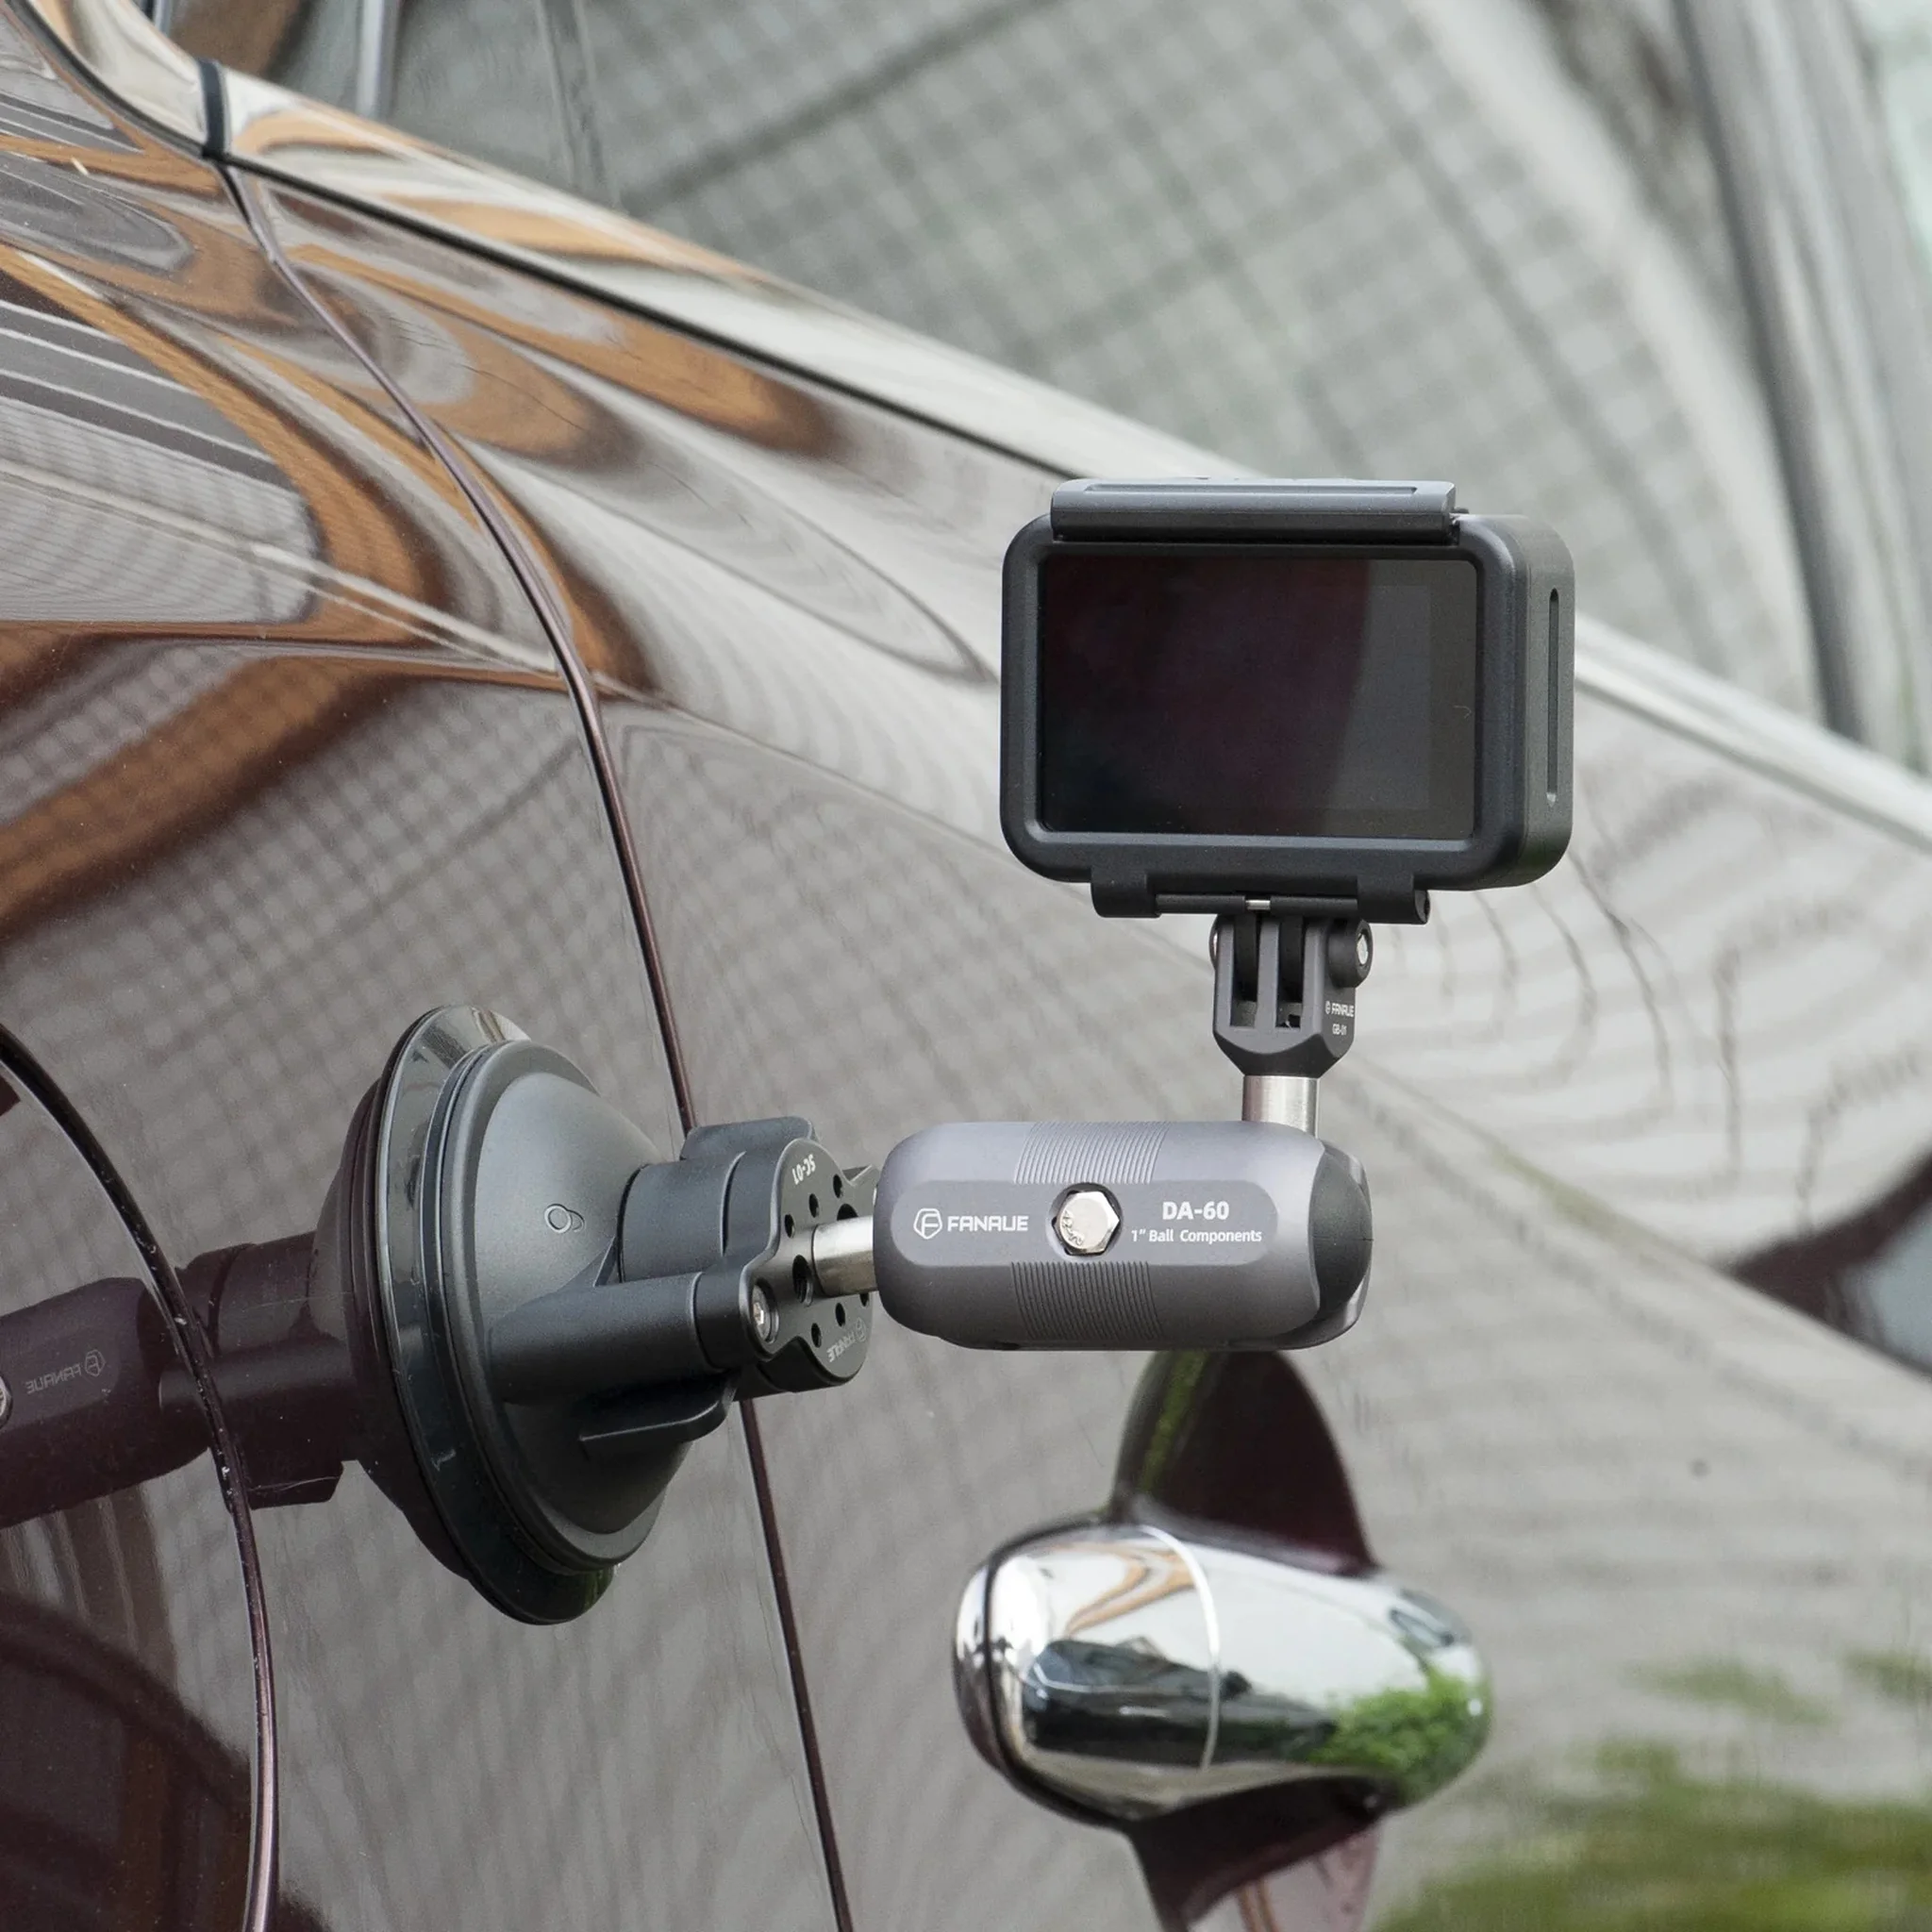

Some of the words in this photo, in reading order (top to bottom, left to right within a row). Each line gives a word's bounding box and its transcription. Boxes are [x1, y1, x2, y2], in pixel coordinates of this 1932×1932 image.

[791, 1154, 816, 1185] SC-01
[1162, 1201, 1230, 1221] DA-60
[1149, 1229, 1174, 1242] Ball
[1180, 1229, 1262, 1244] Components
